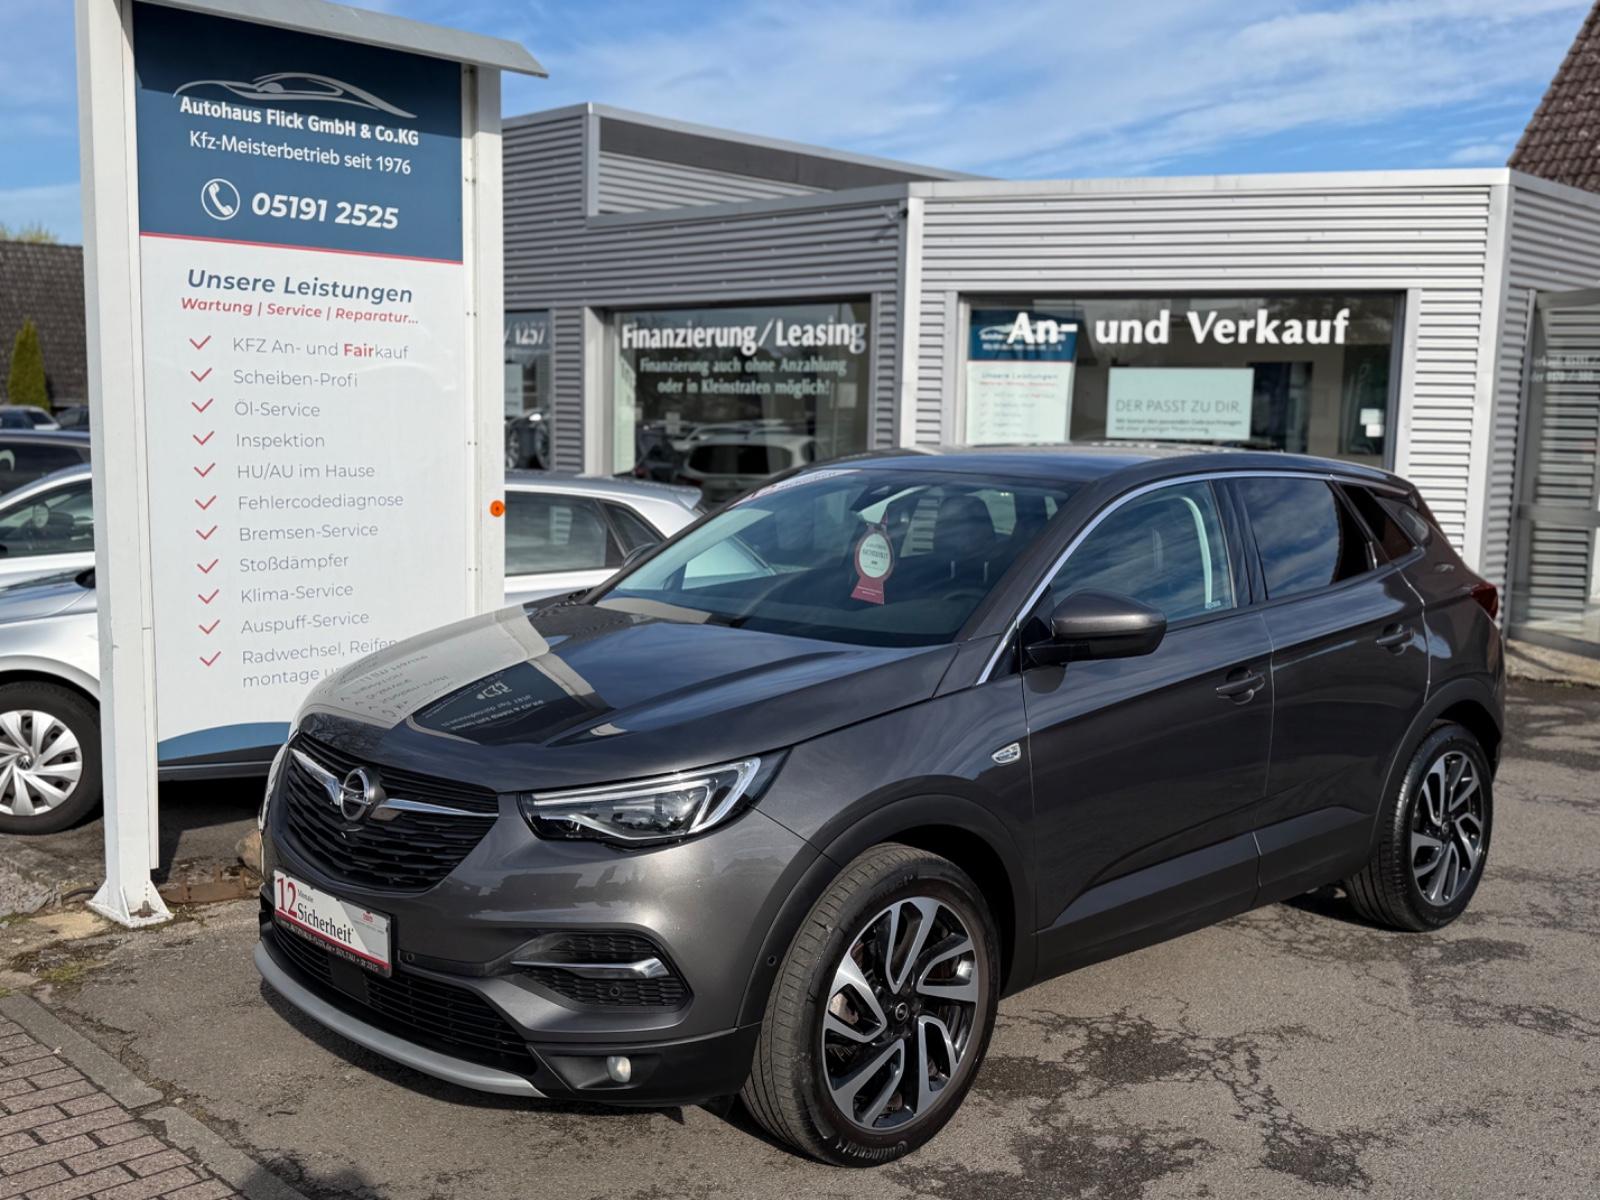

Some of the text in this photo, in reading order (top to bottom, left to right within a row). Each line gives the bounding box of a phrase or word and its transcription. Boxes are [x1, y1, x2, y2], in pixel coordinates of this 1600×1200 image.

[180, 96, 419, 146] Autohaus Flick GmbH & Co.KG
[190, 131, 411, 175] Kfz-Meisterbetrieb seit 1976
[252, 192, 399, 230] 05191 2525
[188, 269, 413, 305] Unsere Leistungen
[181, 297, 253, 315] Wartung
[267, 303, 322, 318] Service
[335, 308, 419, 324] Reparatur...
[1007, 308, 1350, 345] An- und Verkauf
[233, 337, 409, 360] KFZ An- und Fairkauf
[640, 356, 847, 377] Finanzierung auch ohne Anzahlung
[233, 370, 358, 388] Scheiben-Profi
[657, 378, 683, 394] oder
[687, 379, 698, 393] in
[775, 378, 831, 398] möglich!
[234, 400, 320, 417] Öl-Service
[1115, 399, 1142, 412] DER
[1146, 399, 1188, 413] PASST
[1191, 400, 1211, 413] ZU
[236, 432, 325, 451] Inspektion
[237, 463, 375, 480] HU/AU im Hause
[238, 493, 404, 511] Fehlercodediagnose
[239, 524, 379, 542] Bremsen-Service
[239, 554, 349, 573] Stoßdämpfer
[241, 584, 354, 604] Klima-Service
[241, 611, 370, 635] Auspuff-Service
[242, 641, 345, 665] Radwechsel,
[243, 668, 320, 688] montage
[277, 878, 298, 918] 12
